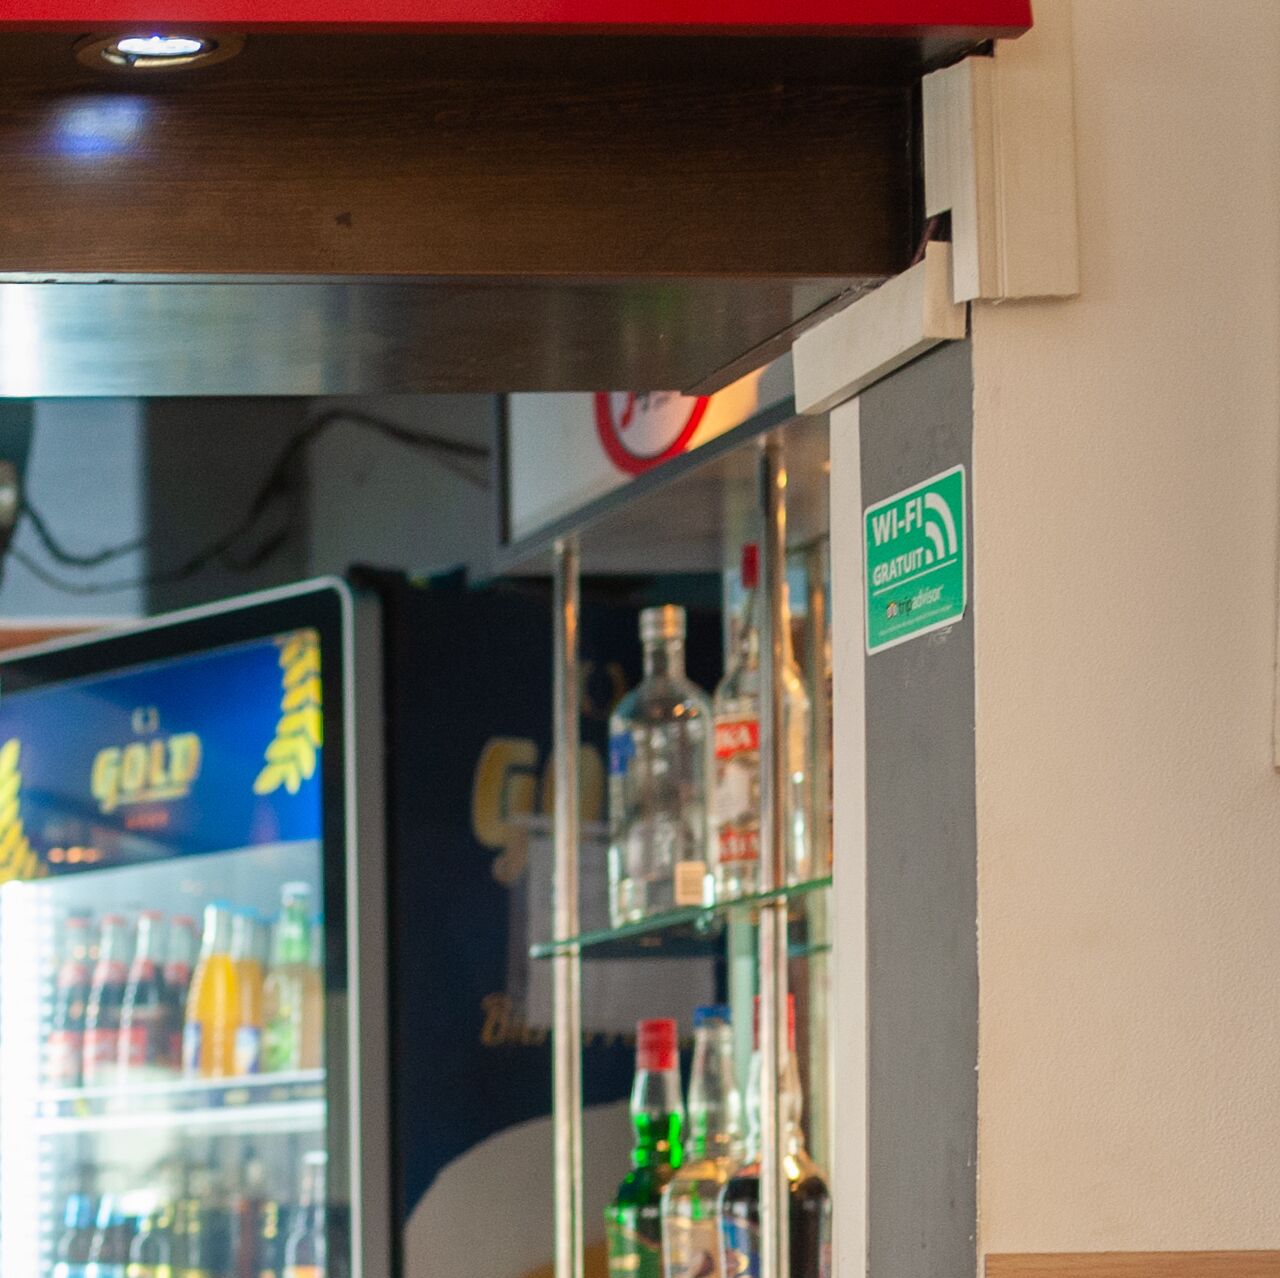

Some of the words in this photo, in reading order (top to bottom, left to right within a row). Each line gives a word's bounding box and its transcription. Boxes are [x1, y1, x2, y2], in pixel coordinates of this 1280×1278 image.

[872, 496, 922, 547] WI-FI
[873, 546, 924, 586] GRATUIT
[92, 731, 202, 814] GOLD
